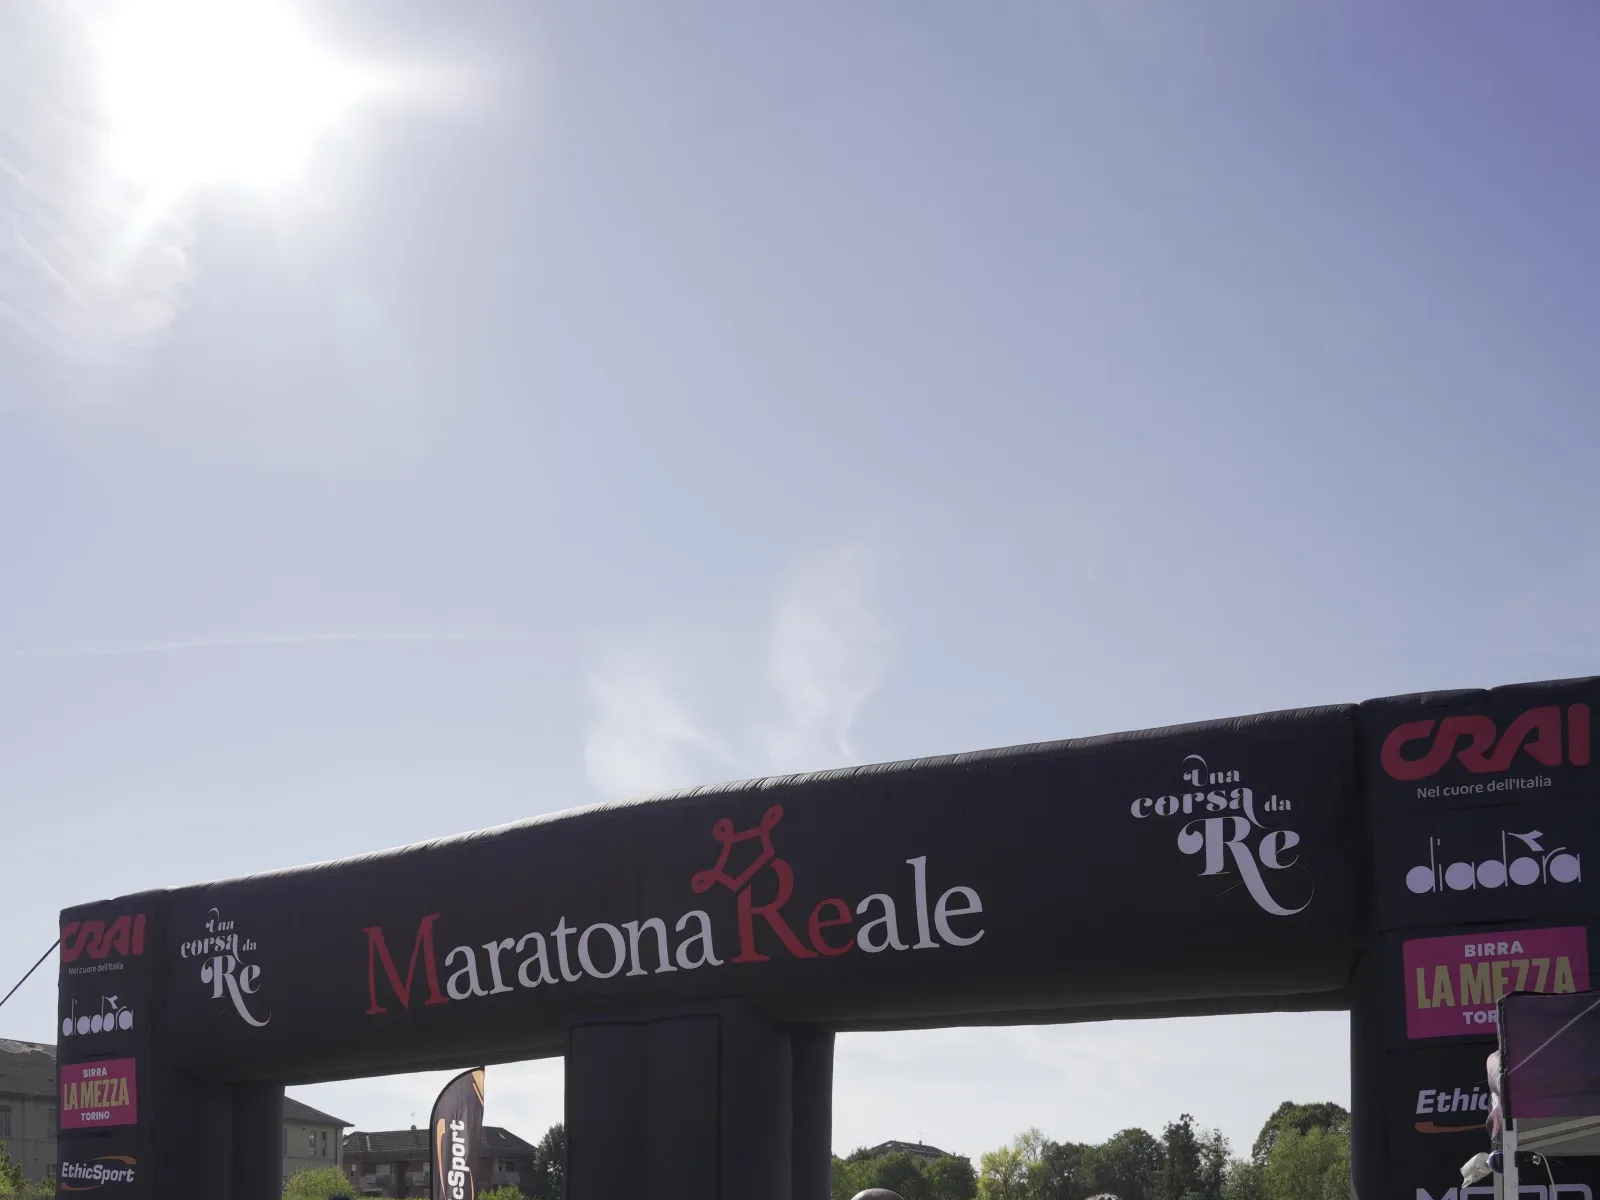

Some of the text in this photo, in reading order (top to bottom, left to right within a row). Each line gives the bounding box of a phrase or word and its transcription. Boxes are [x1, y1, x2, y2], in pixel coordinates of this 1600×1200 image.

[1381, 703, 1591, 781] CRAI
[1183, 754, 1241, 788] Una
[1417, 776, 1552, 800] Nel cuore dell'Italia
[1131, 781, 1292, 830] corsa da
[1177, 815, 1315, 916] Re
[1405, 829, 1582, 894] diadora
[205, 907, 235, 933] Una
[362, 855, 985, 1015] Maratona Reale
[60, 913, 147, 963] CRAI
[180, 933, 257, 964] corsa da
[1464, 940, 1524, 958] BIRRA
[68, 966, 79, 975] Nel
[79, 965, 97, 974] cuore
[1416, 964, 1456, 1010] LA
[200, 954, 272, 1027] Re
[62, 994, 134, 1037] diadora
[1462, 1010, 1498, 1025] TOR
[82, 1067, 108, 1079] BIRRA
[63, 1077, 130, 1111] LA MEZZA
[1415, 1086, 1490, 1115] Ethic
[81, 1111, 111, 1122] TORINO
[61, 1161, 136, 1185] EthicSport
